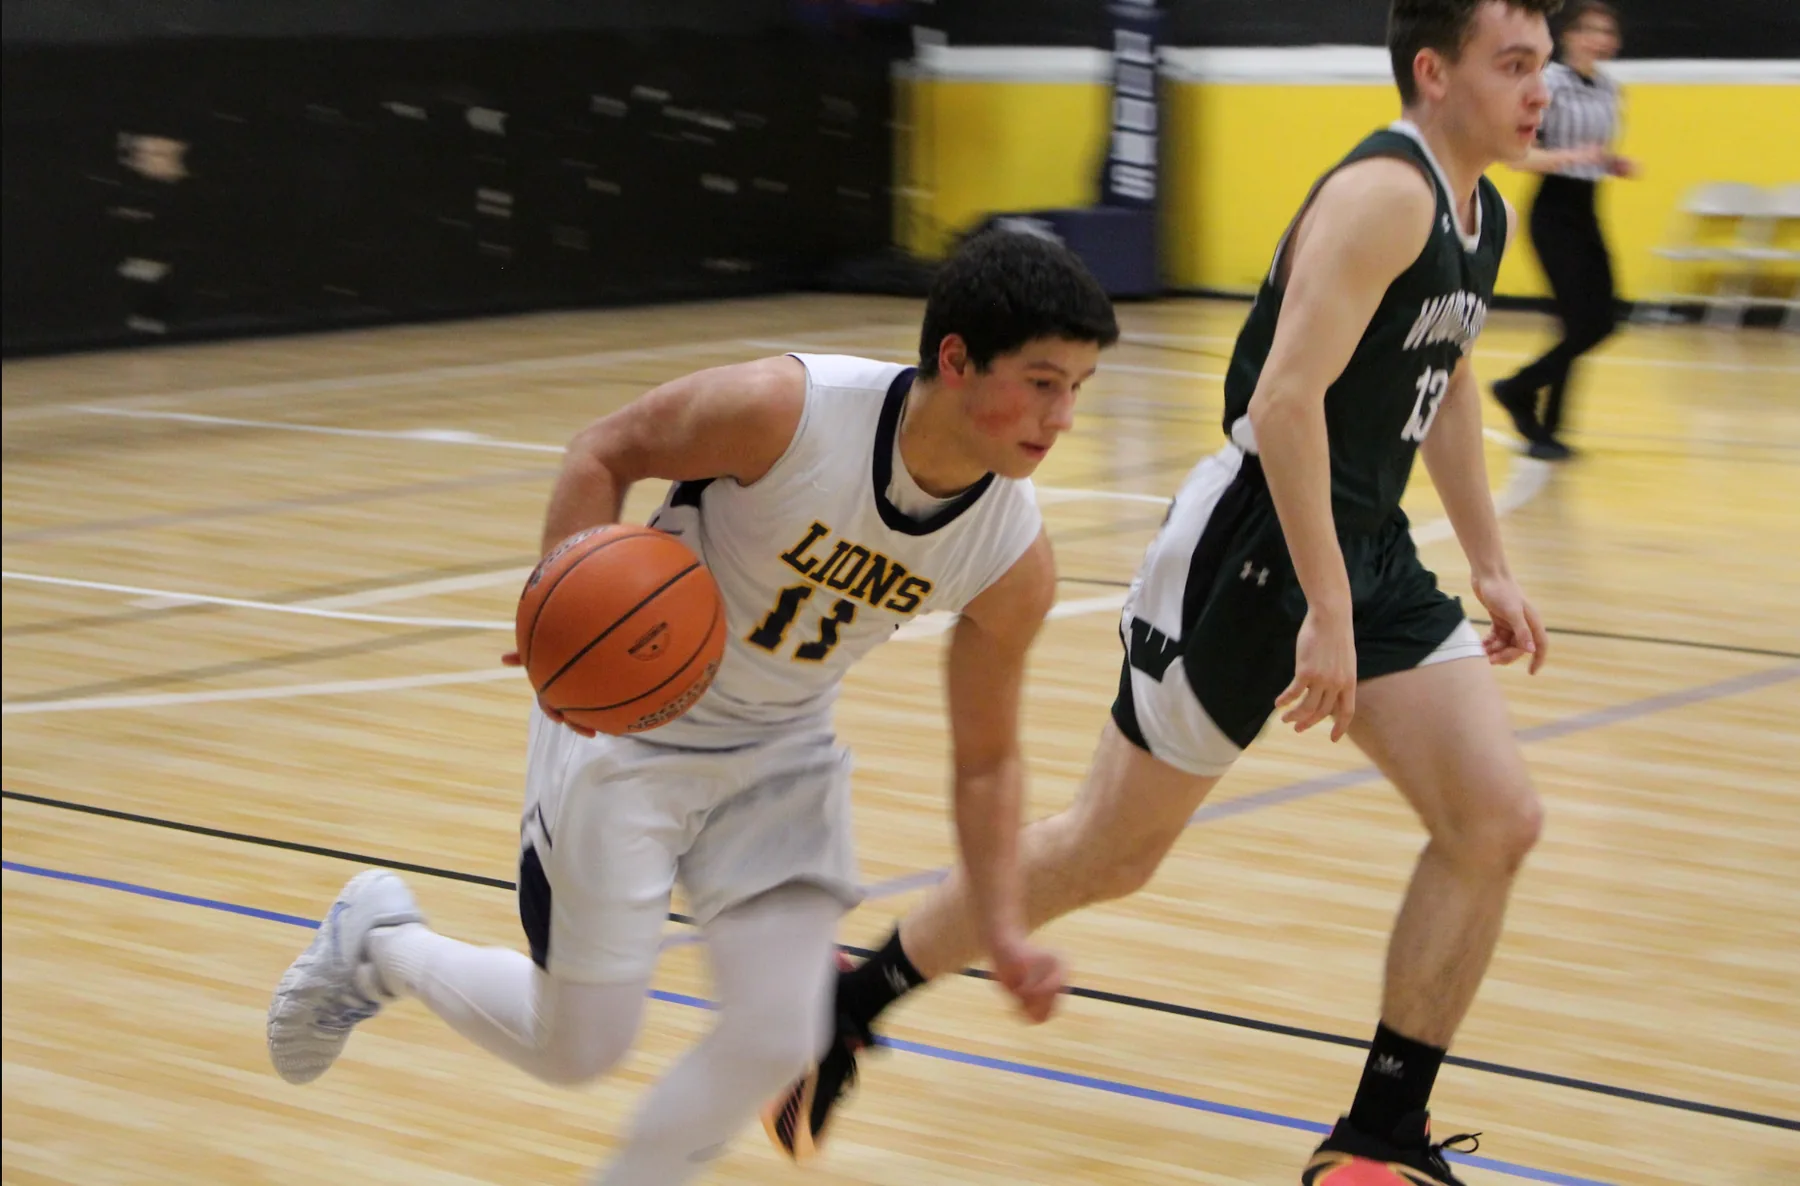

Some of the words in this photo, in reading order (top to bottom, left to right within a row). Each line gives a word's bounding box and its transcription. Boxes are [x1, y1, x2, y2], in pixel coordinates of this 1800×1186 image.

[1400, 365, 1449, 441] 13
[780, 521, 933, 613] LIONS
[746, 586, 856, 662] 11
